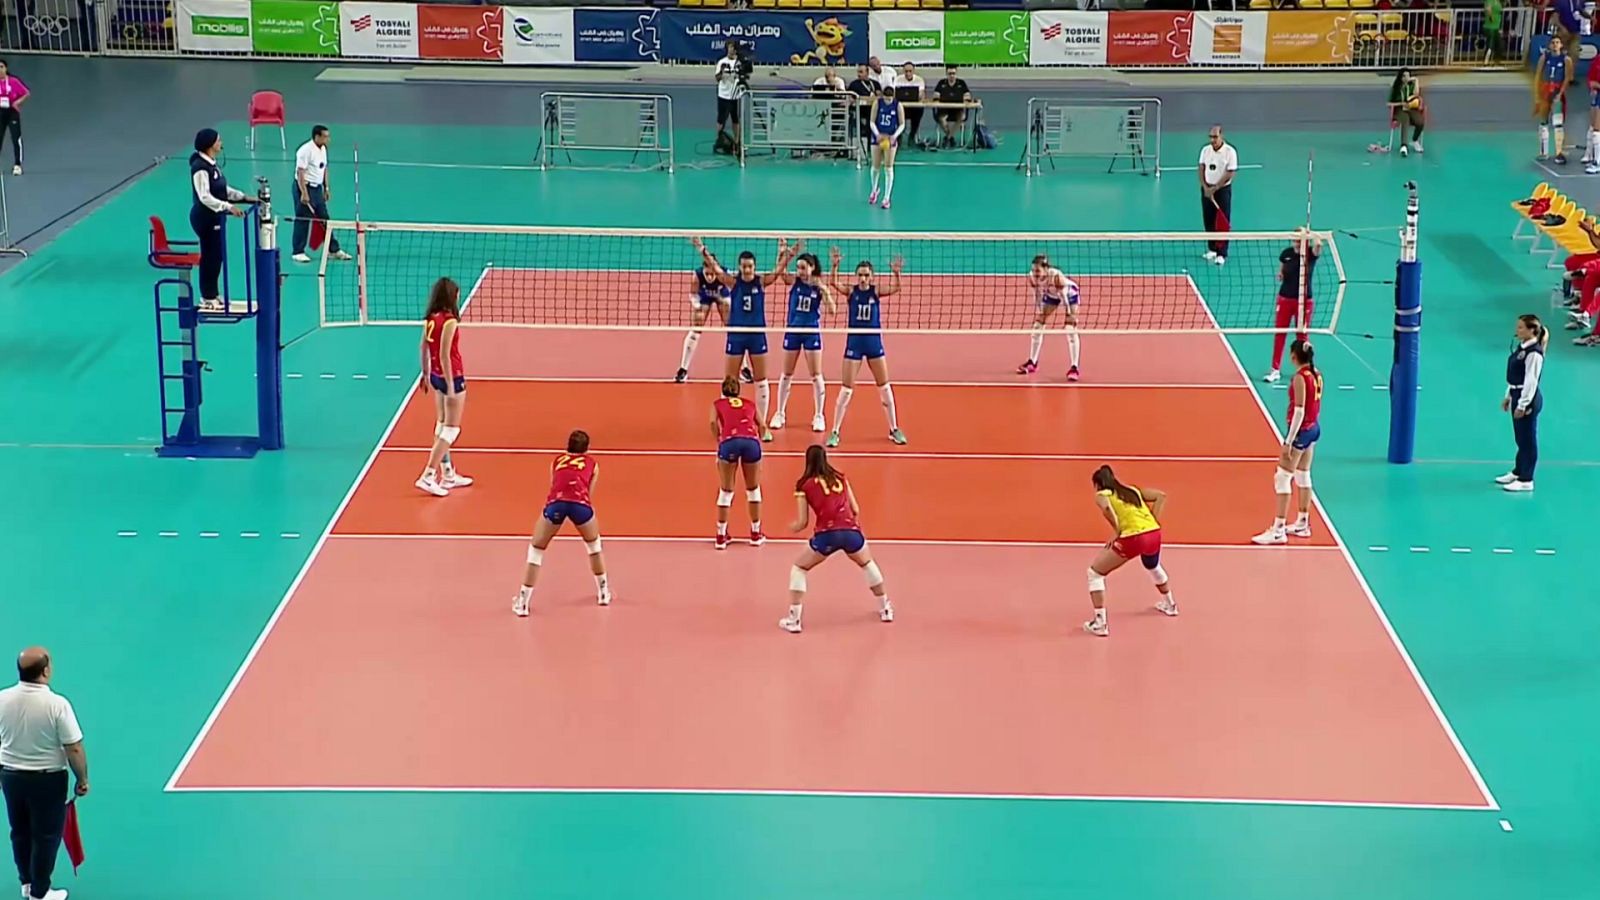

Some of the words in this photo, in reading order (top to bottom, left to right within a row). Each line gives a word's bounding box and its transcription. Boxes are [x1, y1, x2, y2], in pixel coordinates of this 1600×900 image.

[197, 23, 244, 33] mobilis
[376, 28, 411, 36] ALGERIE
[685, 23, 721, 36] القلب
[722, 23, 743, 37] في
[744, 24, 781, 38] وهران
[891, 36, 936, 47] mobilis
[880, 114, 891, 126] 15
[743, 295, 752, 311] 3
[856, 304, 871, 321] 10
[729, 397, 743, 408] 9
[555, 454, 586, 471] 24
